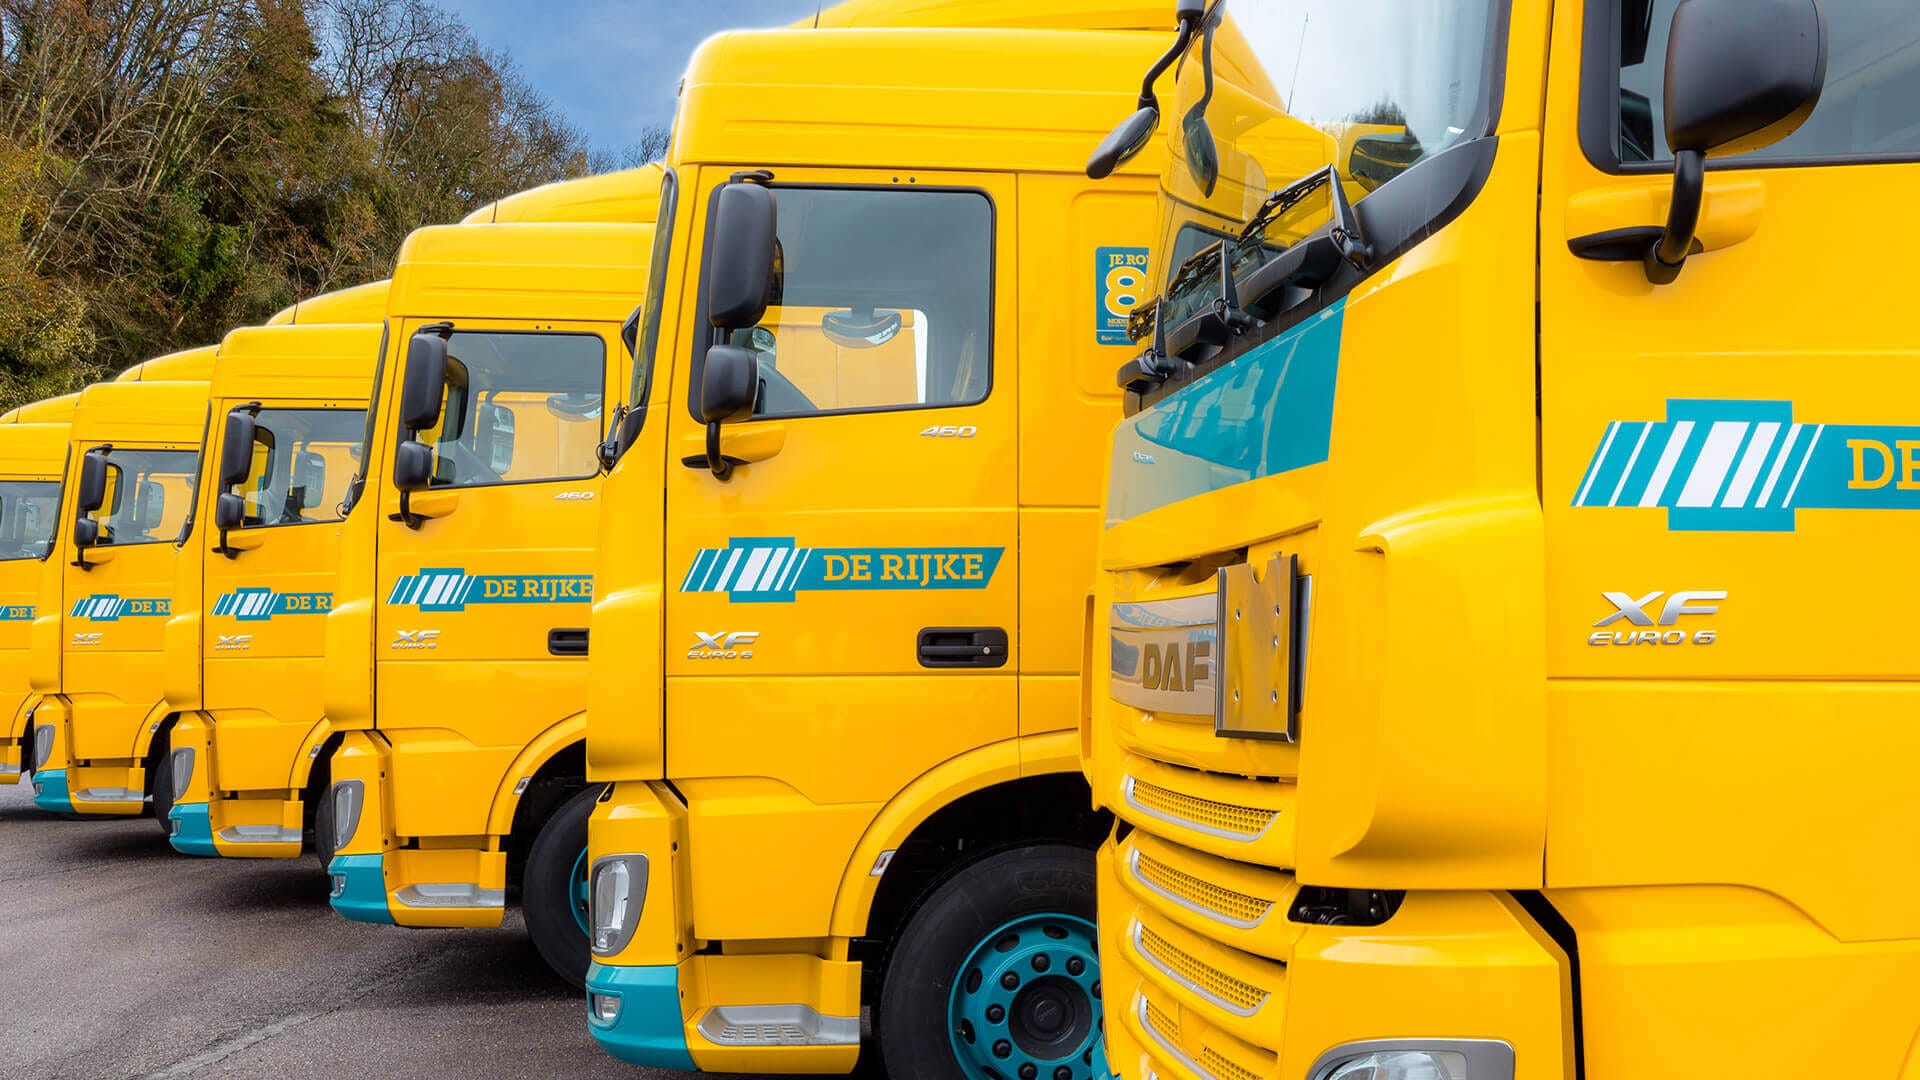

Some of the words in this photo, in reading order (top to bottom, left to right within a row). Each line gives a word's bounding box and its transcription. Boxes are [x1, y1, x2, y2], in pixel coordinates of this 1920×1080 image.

[1109, 254, 1124, 267] JE
[920, 425, 977, 438] 460
[1846, 438, 1920, 490] DE
[555, 491, 595, 501] 460
[824, 554, 871, 582] DE
[880, 553, 984, 586] RIJKE
[483, 579, 517, 598] DE
[523, 578, 593, 601] RIJKE
[131, 601, 152, 613] DE
[285, 595, 311, 611] DE
[1592, 590, 1729, 628] XF
[9, 607, 27, 618] DE
[216, 634, 254, 646] XF
[393, 629, 441, 643] XF
[689, 631, 760, 650] XF
[1588, 631, 1686, 646] EURO
[1692, 630, 1717, 646] 6
[687, 650, 738, 660] EURO
[740, 650, 753, 660] 6
[1142, 641, 1211, 692] DAF
